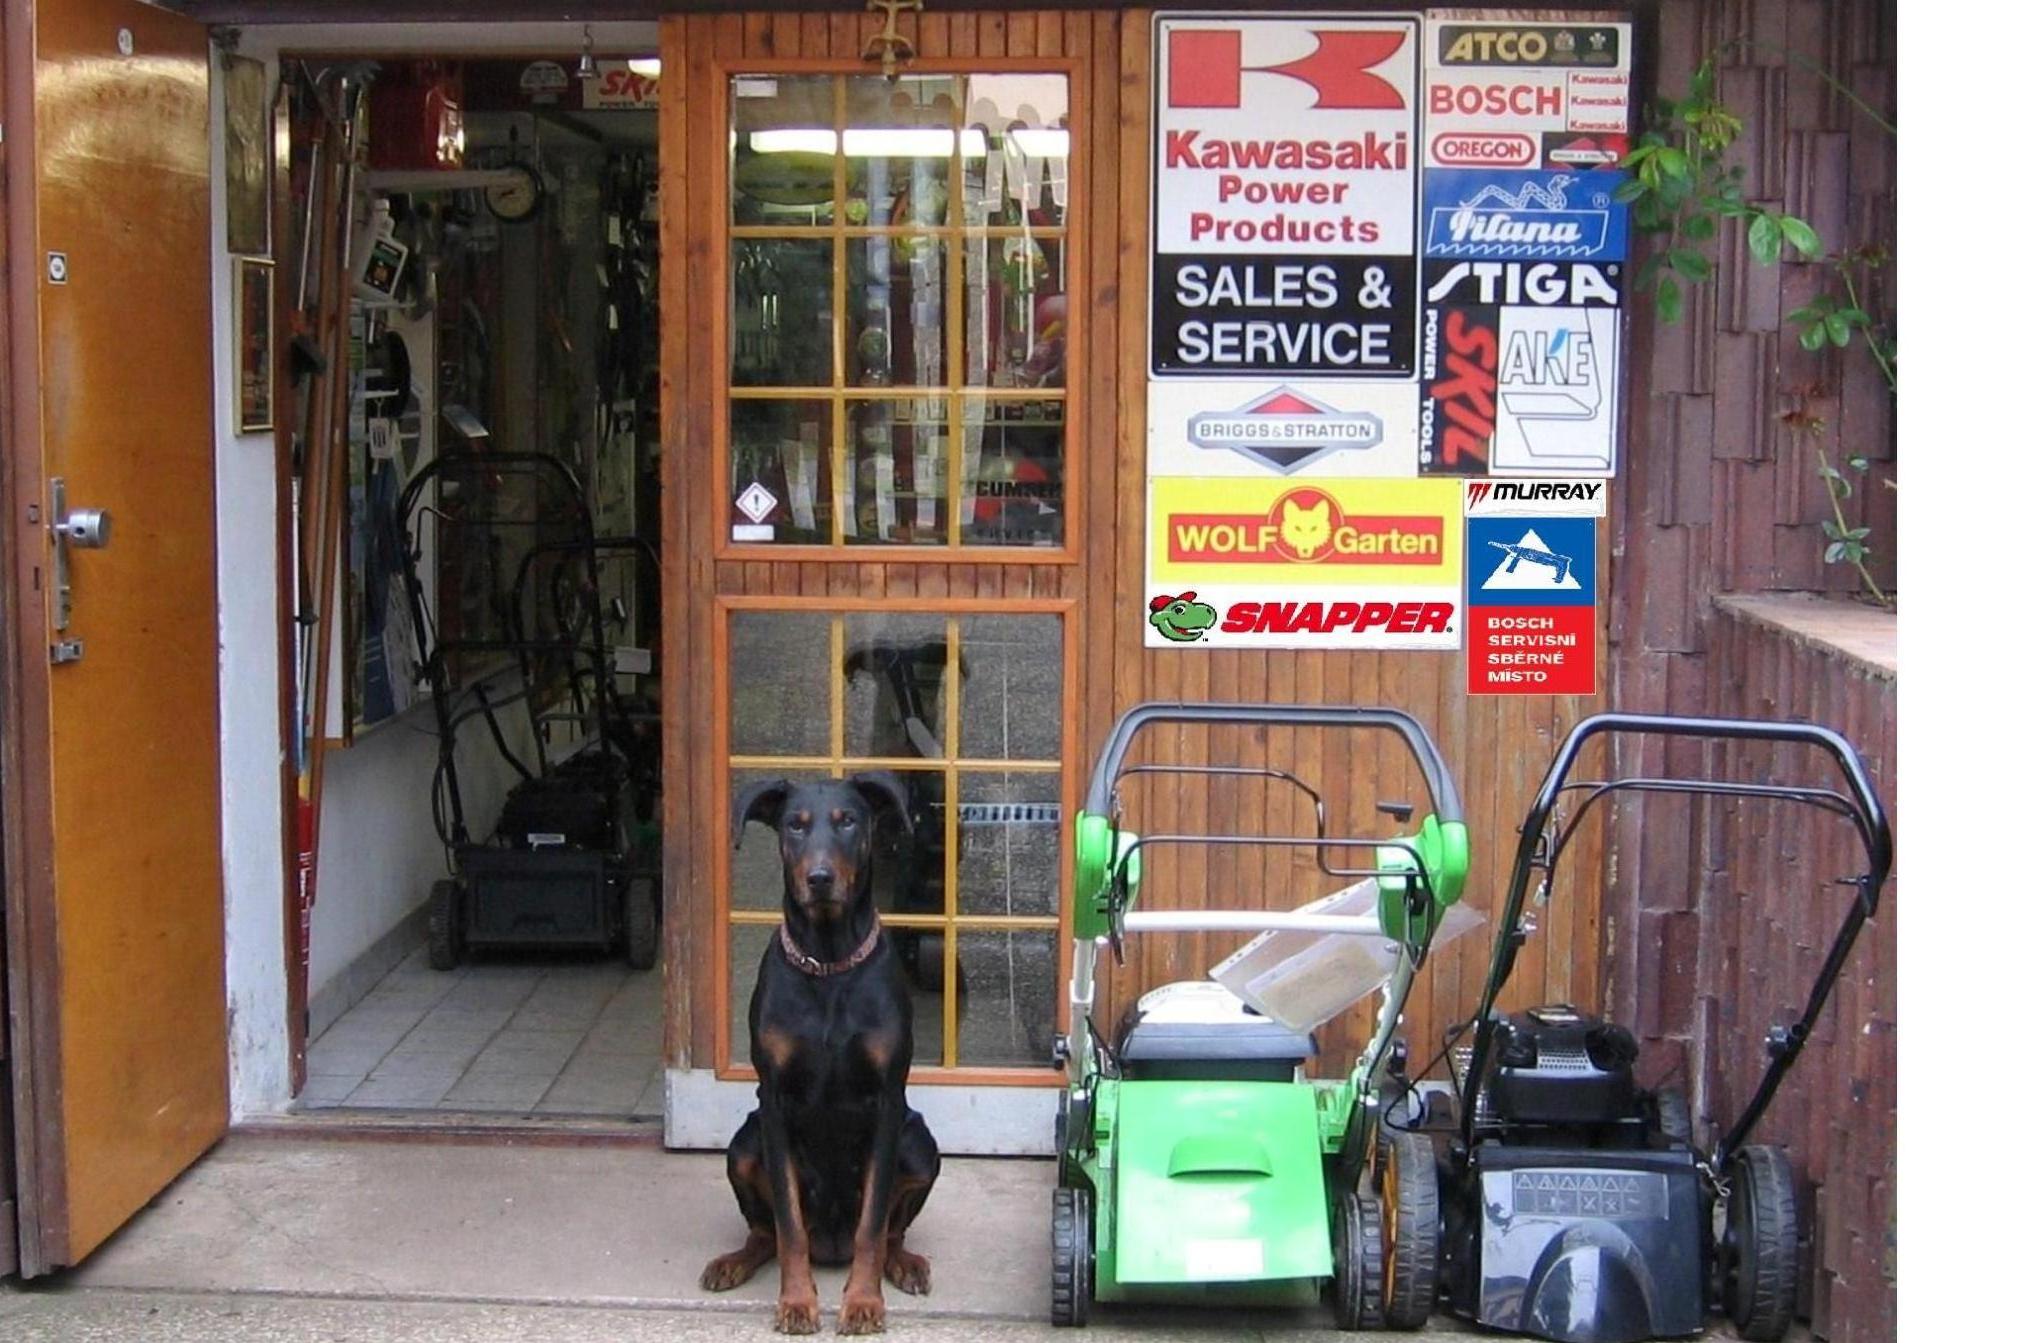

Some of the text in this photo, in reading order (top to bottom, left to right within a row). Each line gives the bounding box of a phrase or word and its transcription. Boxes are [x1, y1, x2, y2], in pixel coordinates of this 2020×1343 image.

[1444, 31, 1548, 62] ATCO
[600, 70, 660, 102] SKI
[1572, 74, 1628, 85] Kawasaki
[1430, 85, 1561, 116] BOSCH
[1571, 96, 1627, 106] Kawasaki
[1570, 120, 1626, 131] Kawasaki
[1166, 130, 1408, 170] Kawasaki
[1443, 141, 1522, 159] OREGON
[1219, 175, 1349, 204] Power
[1190, 212, 1380, 243] Products
[1176, 265, 1392, 308] SALES &
[1427, 262, 1618, 305] STIGA
[1177, 320, 1391, 365] SERVICE
[1500, 329, 1592, 386] AKE
[1420, 309, 1438, 464] POWER TOOLS
[1430, 310, 1497, 465] SKIL
[1493, 482, 1602, 500] MURRAY
[1176, 524, 1438, 554] WOLF Garten
[1220, 602, 1455, 633] SNAPPER
[1487, 617, 1554, 629] BOSCH
[1487, 633, 1577, 646] SERVISNÍ
[1487, 650, 1565, 665] SBĚRNÉ
[1487, 669, 1548, 683] MÍSTO
